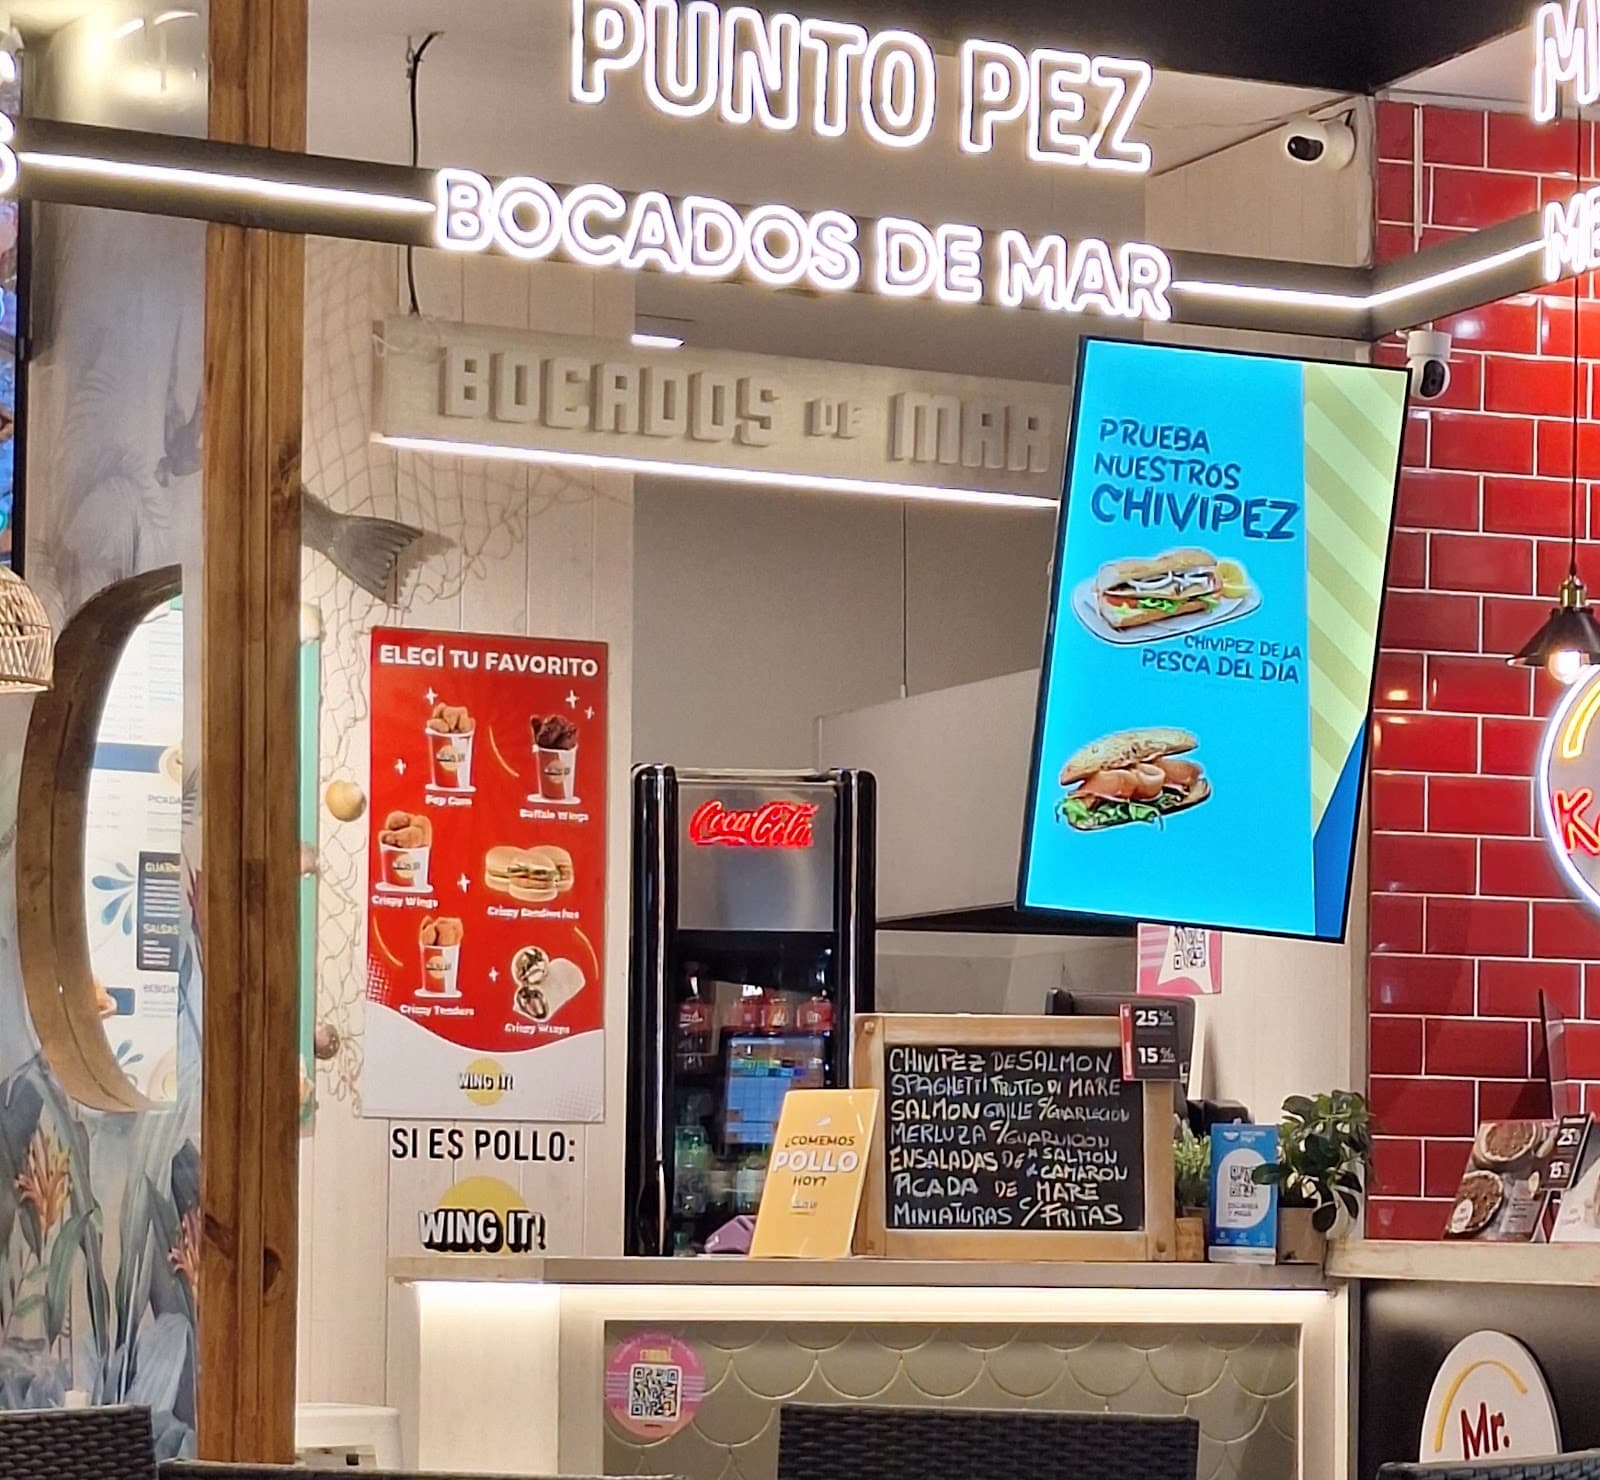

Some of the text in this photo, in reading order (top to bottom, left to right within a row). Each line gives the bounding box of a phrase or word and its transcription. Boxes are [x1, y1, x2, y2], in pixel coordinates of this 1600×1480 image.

[571, 0, 1153, 173] PUNTO PEZ
[435, 168, 1172, 321] BOCADOS DE MAR
[441, 345, 1053, 473] BOCADOS DE MAR
[1100, 418, 1209, 454] PRUEBA
[1094, 453, 1242, 490] NUESTROS
[1091, 484, 1300, 540] CHIVIPEZ
[1183, 634, 1301, 660] CHIVIPEZ DE LA
[379, 644, 599, 678] ELEGÍ TU FAVORITO
[1142, 648, 1211, 675] PESCA
[1216, 657, 1254, 679] DEL
[690, 800, 819, 848] Coca-Cola
[371, 895, 403, 908] Crispy
[889, 1047, 986, 1073] CHIVIPEZ
[1016, 1051, 1112, 1074] SALMON
[458, 1072, 495, 1090] WING
[891, 1073, 1121, 1098] SPAGHETTI FRUTTO DI MARE
[890, 1098, 981, 1121] SALMON
[392, 1128, 576, 1163] SI ES POLLO:
[785, 1135, 856, 1149] ¿COMEMOS
[891, 1122, 986, 1146] MERLUZA
[771, 1150, 859, 1174] POLLO
[890, 1147, 1118, 1174] ENSALADAS DE SALMON
[1041, 1164, 1128, 1181] CAMARON
[995, 1180, 1018, 1198] DE
[1037, 1179, 1100, 1202] MARE
[893, 1201, 1012, 1227] MINIATURAS
[418, 1208, 547, 1253] WING IT!
[1460, 1402, 1510, 1462] Mr.
